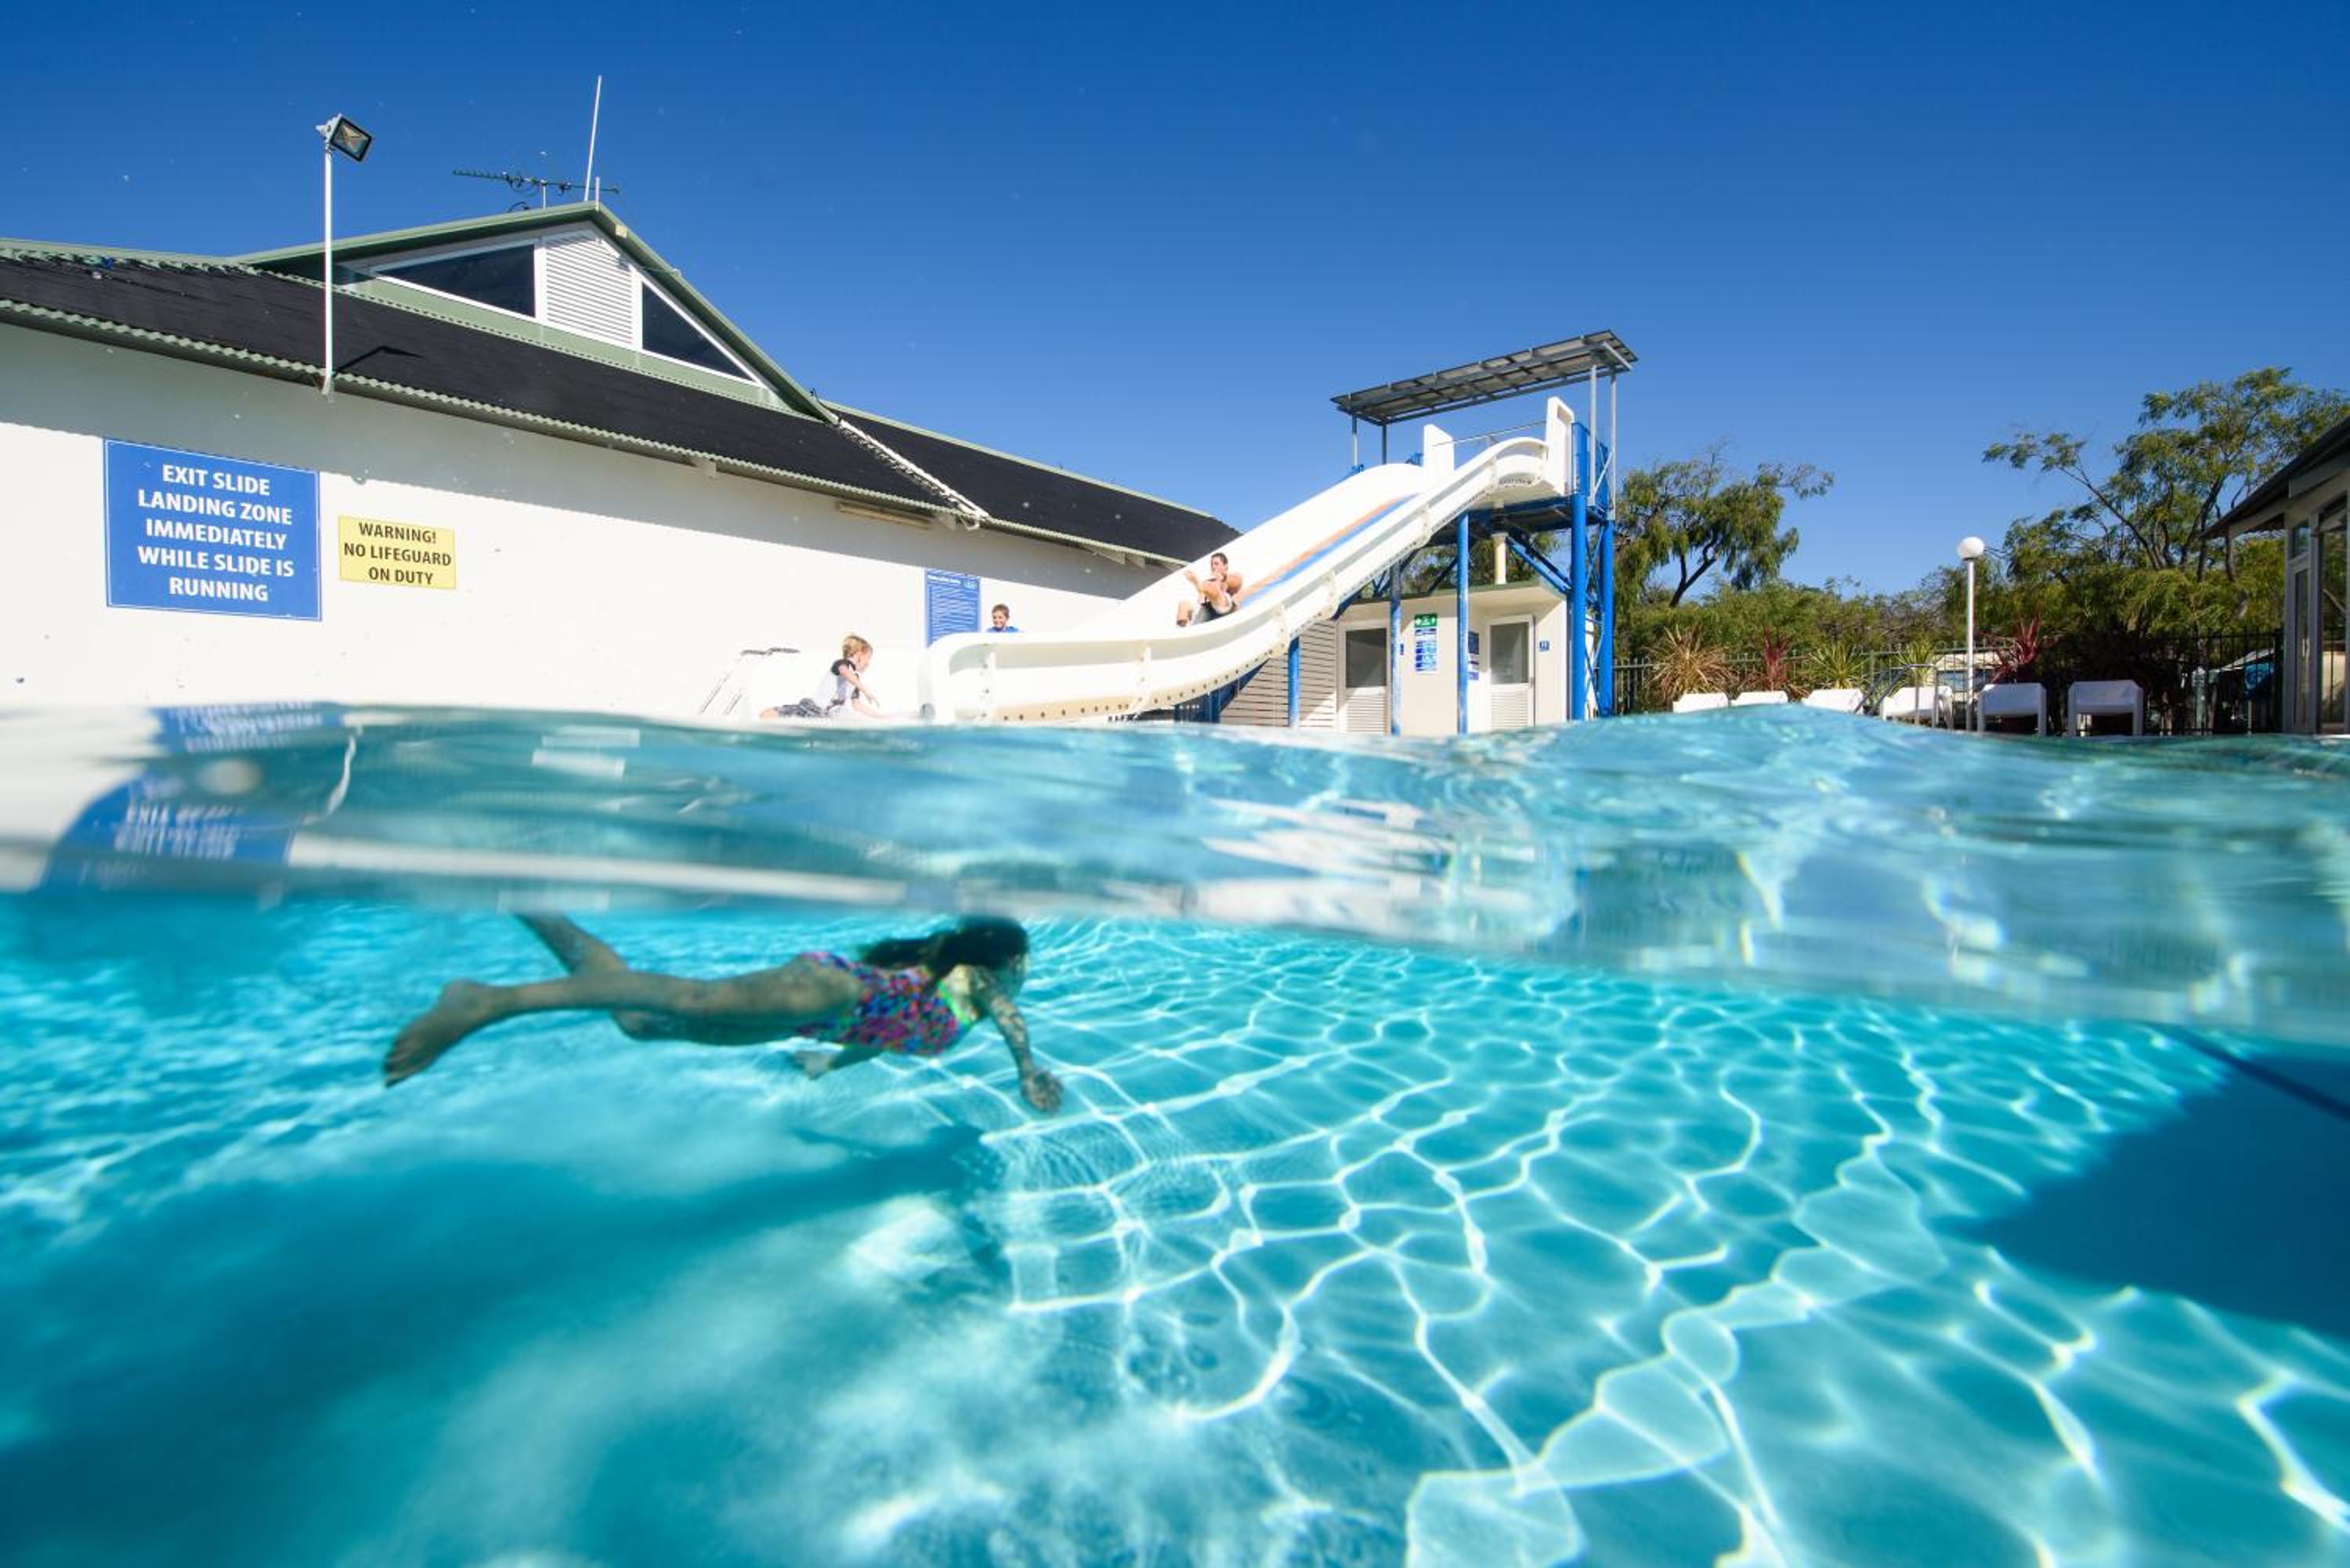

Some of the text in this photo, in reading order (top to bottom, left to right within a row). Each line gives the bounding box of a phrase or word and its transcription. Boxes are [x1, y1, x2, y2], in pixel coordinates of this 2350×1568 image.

[162, 464, 269, 496] EXIT SLIDE
[138, 489, 292, 525] LANDING ZONE
[146, 518, 287, 550] IMMEDIATELY
[358, 522, 436, 544] WARNING!
[137, 546, 294, 577] WHILE SLIDE IS
[344, 542, 452, 566] NO LIFEGUARD
[169, 576, 268, 602] RUNNING
[368, 566, 433, 586] ON DUTY
